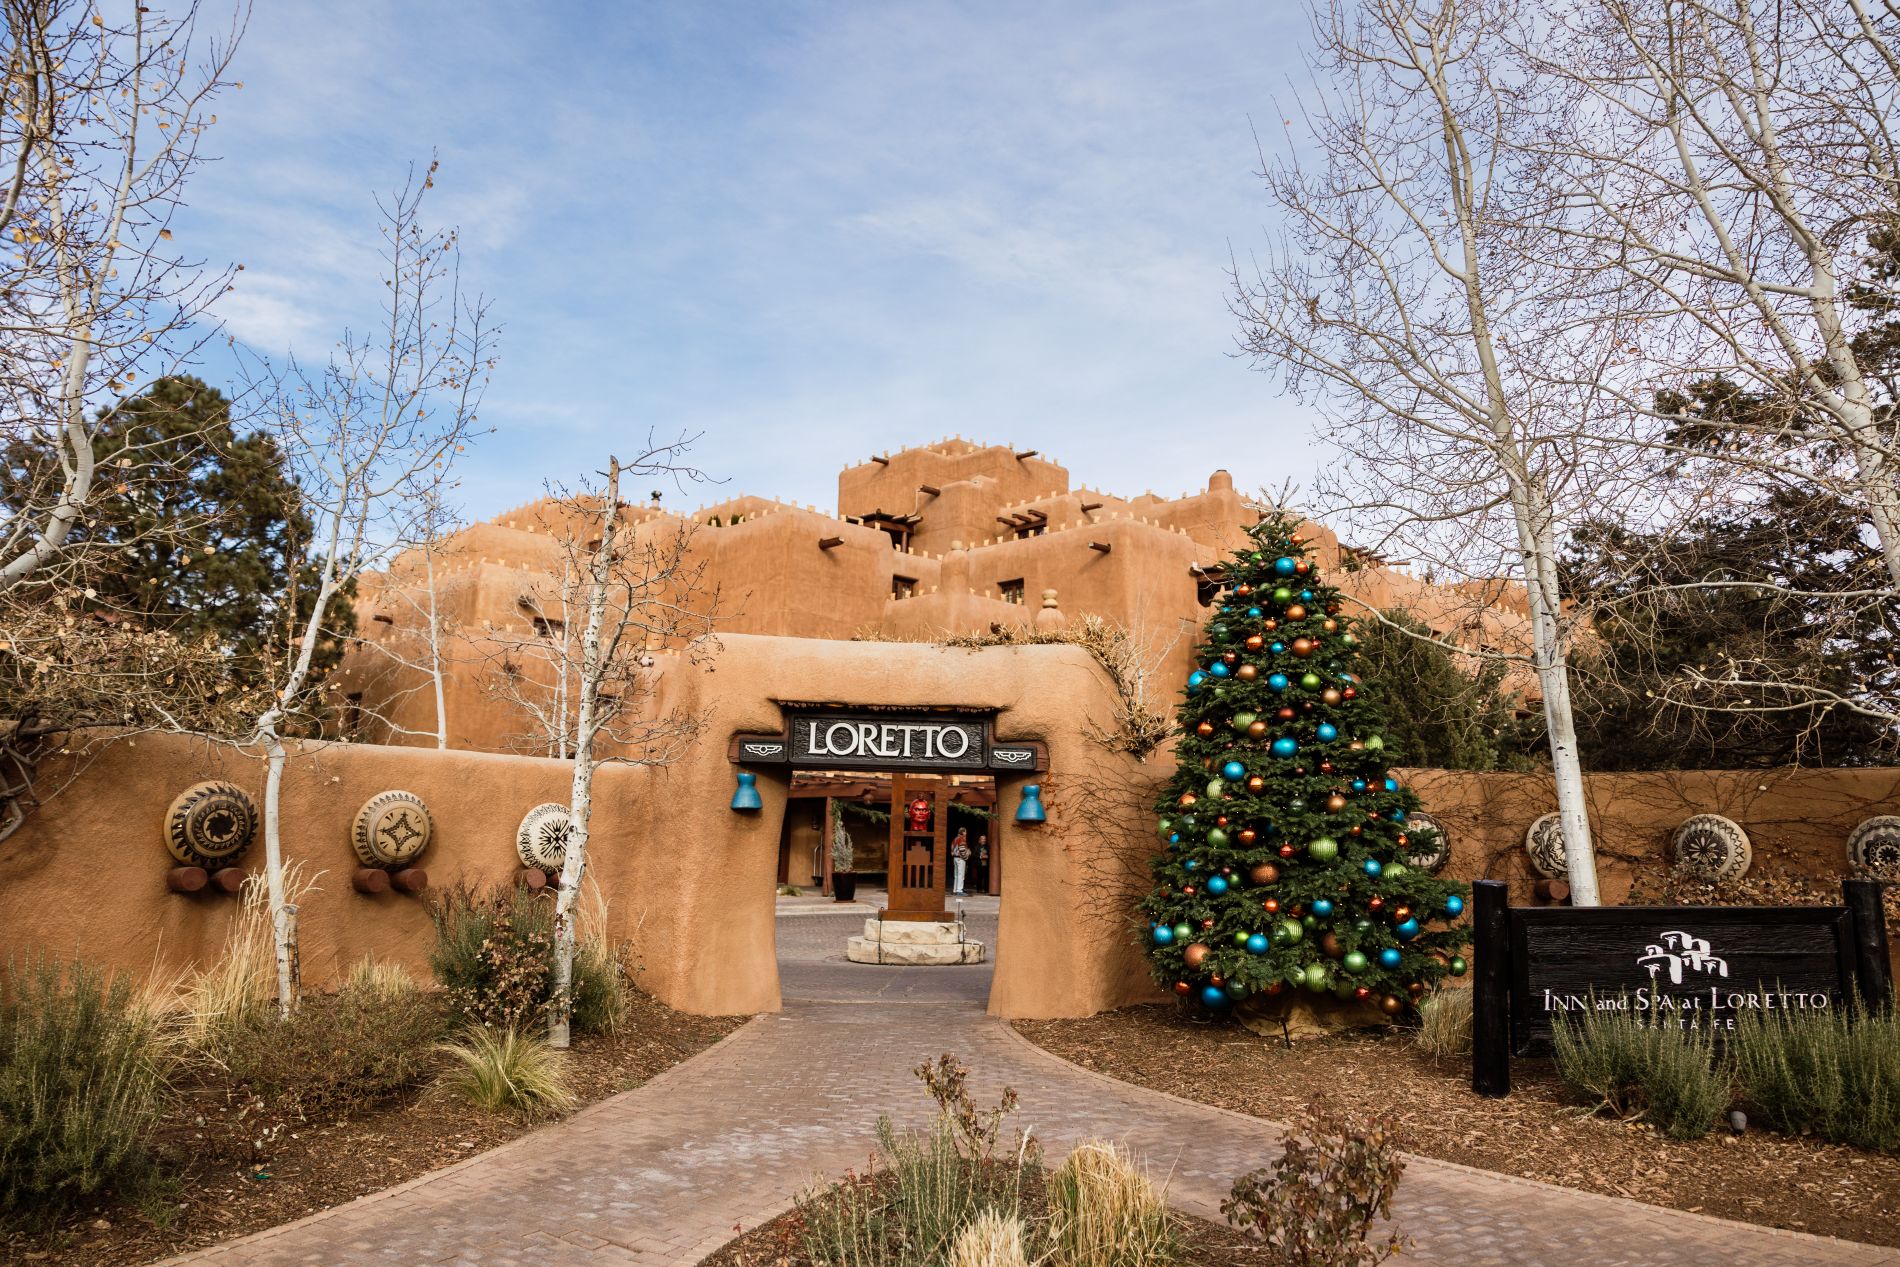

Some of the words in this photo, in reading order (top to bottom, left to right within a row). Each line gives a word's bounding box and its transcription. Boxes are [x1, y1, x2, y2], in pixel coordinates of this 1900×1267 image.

[807, 721, 969, 759] LORETTO
[1596, 995, 1628, 1011] and
[1681, 996, 1702, 1010] at
[1711, 986, 1828, 1010] LORETTO
[1712, 1018, 1735, 1030] FE
